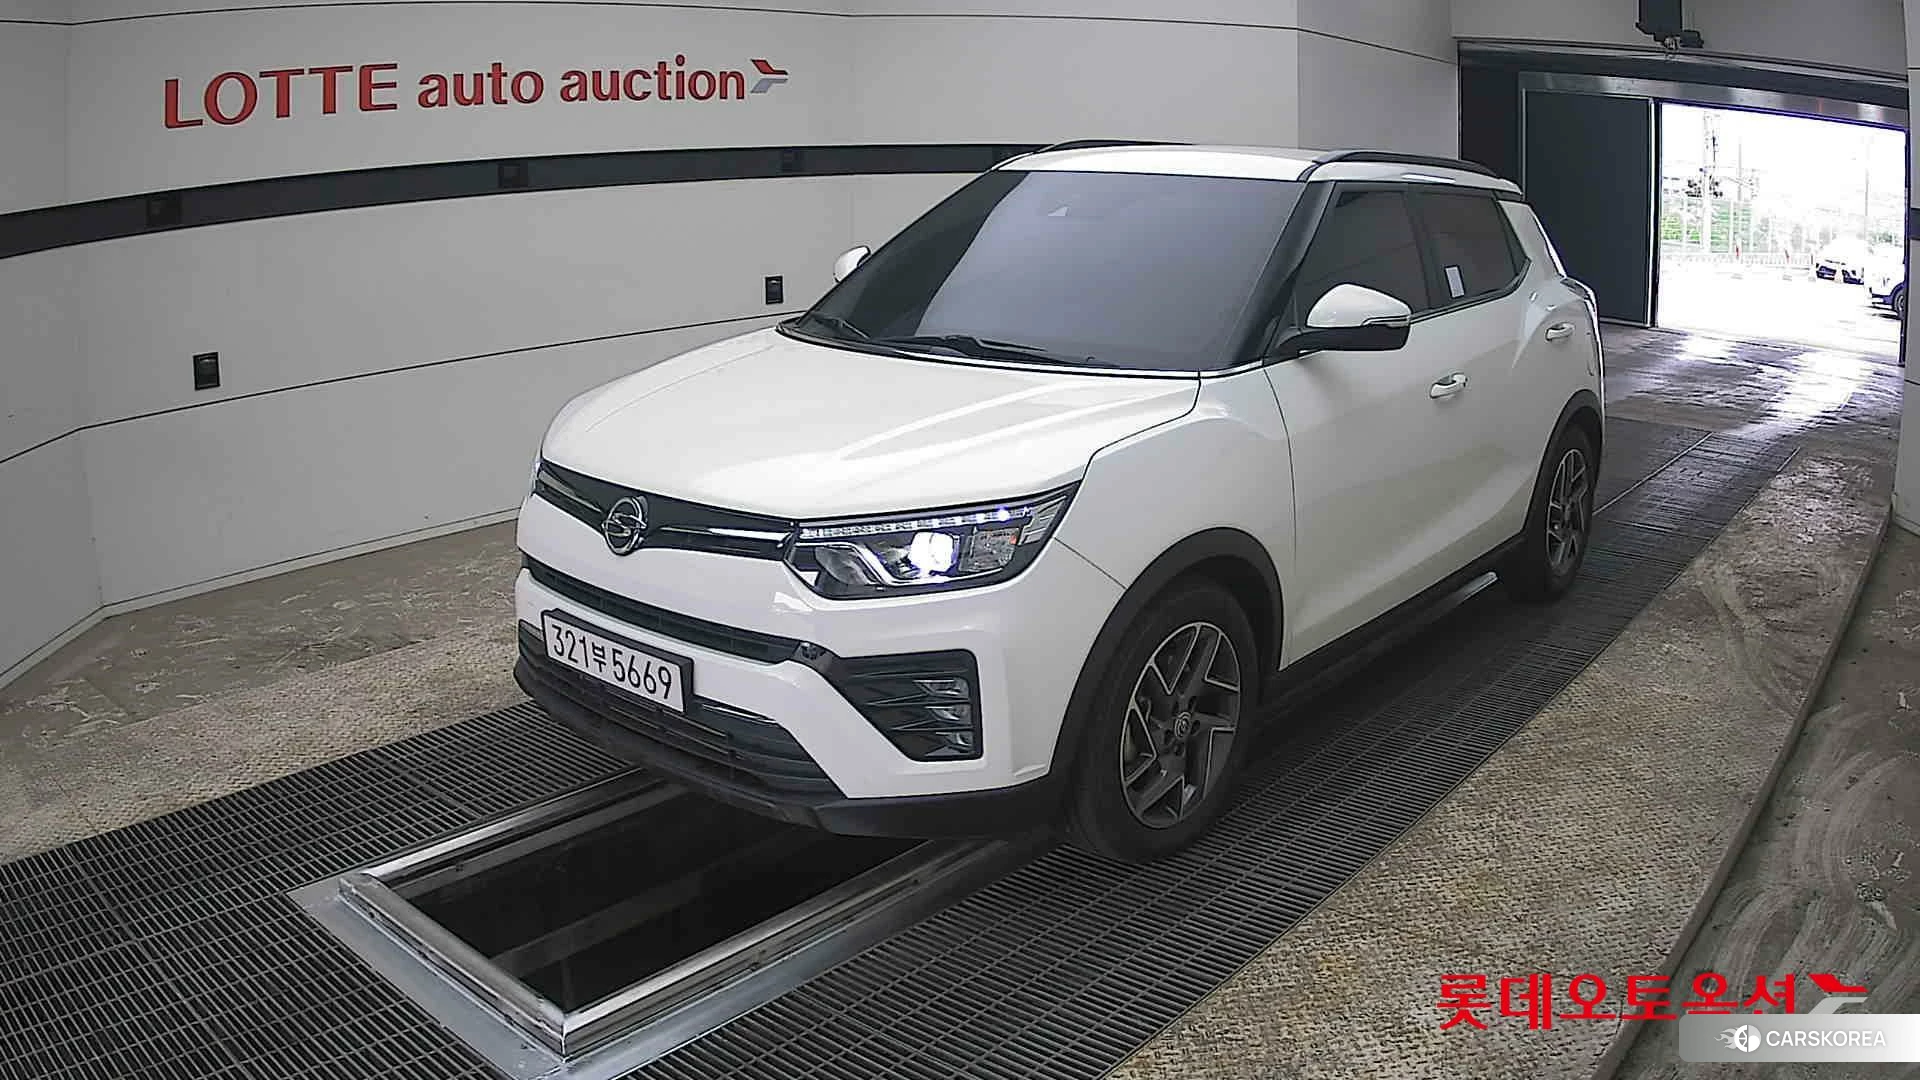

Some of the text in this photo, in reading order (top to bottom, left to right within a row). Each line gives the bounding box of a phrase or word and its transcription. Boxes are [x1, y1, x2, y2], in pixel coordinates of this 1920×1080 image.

[164, 54, 746, 129] LOTTE auto auction
